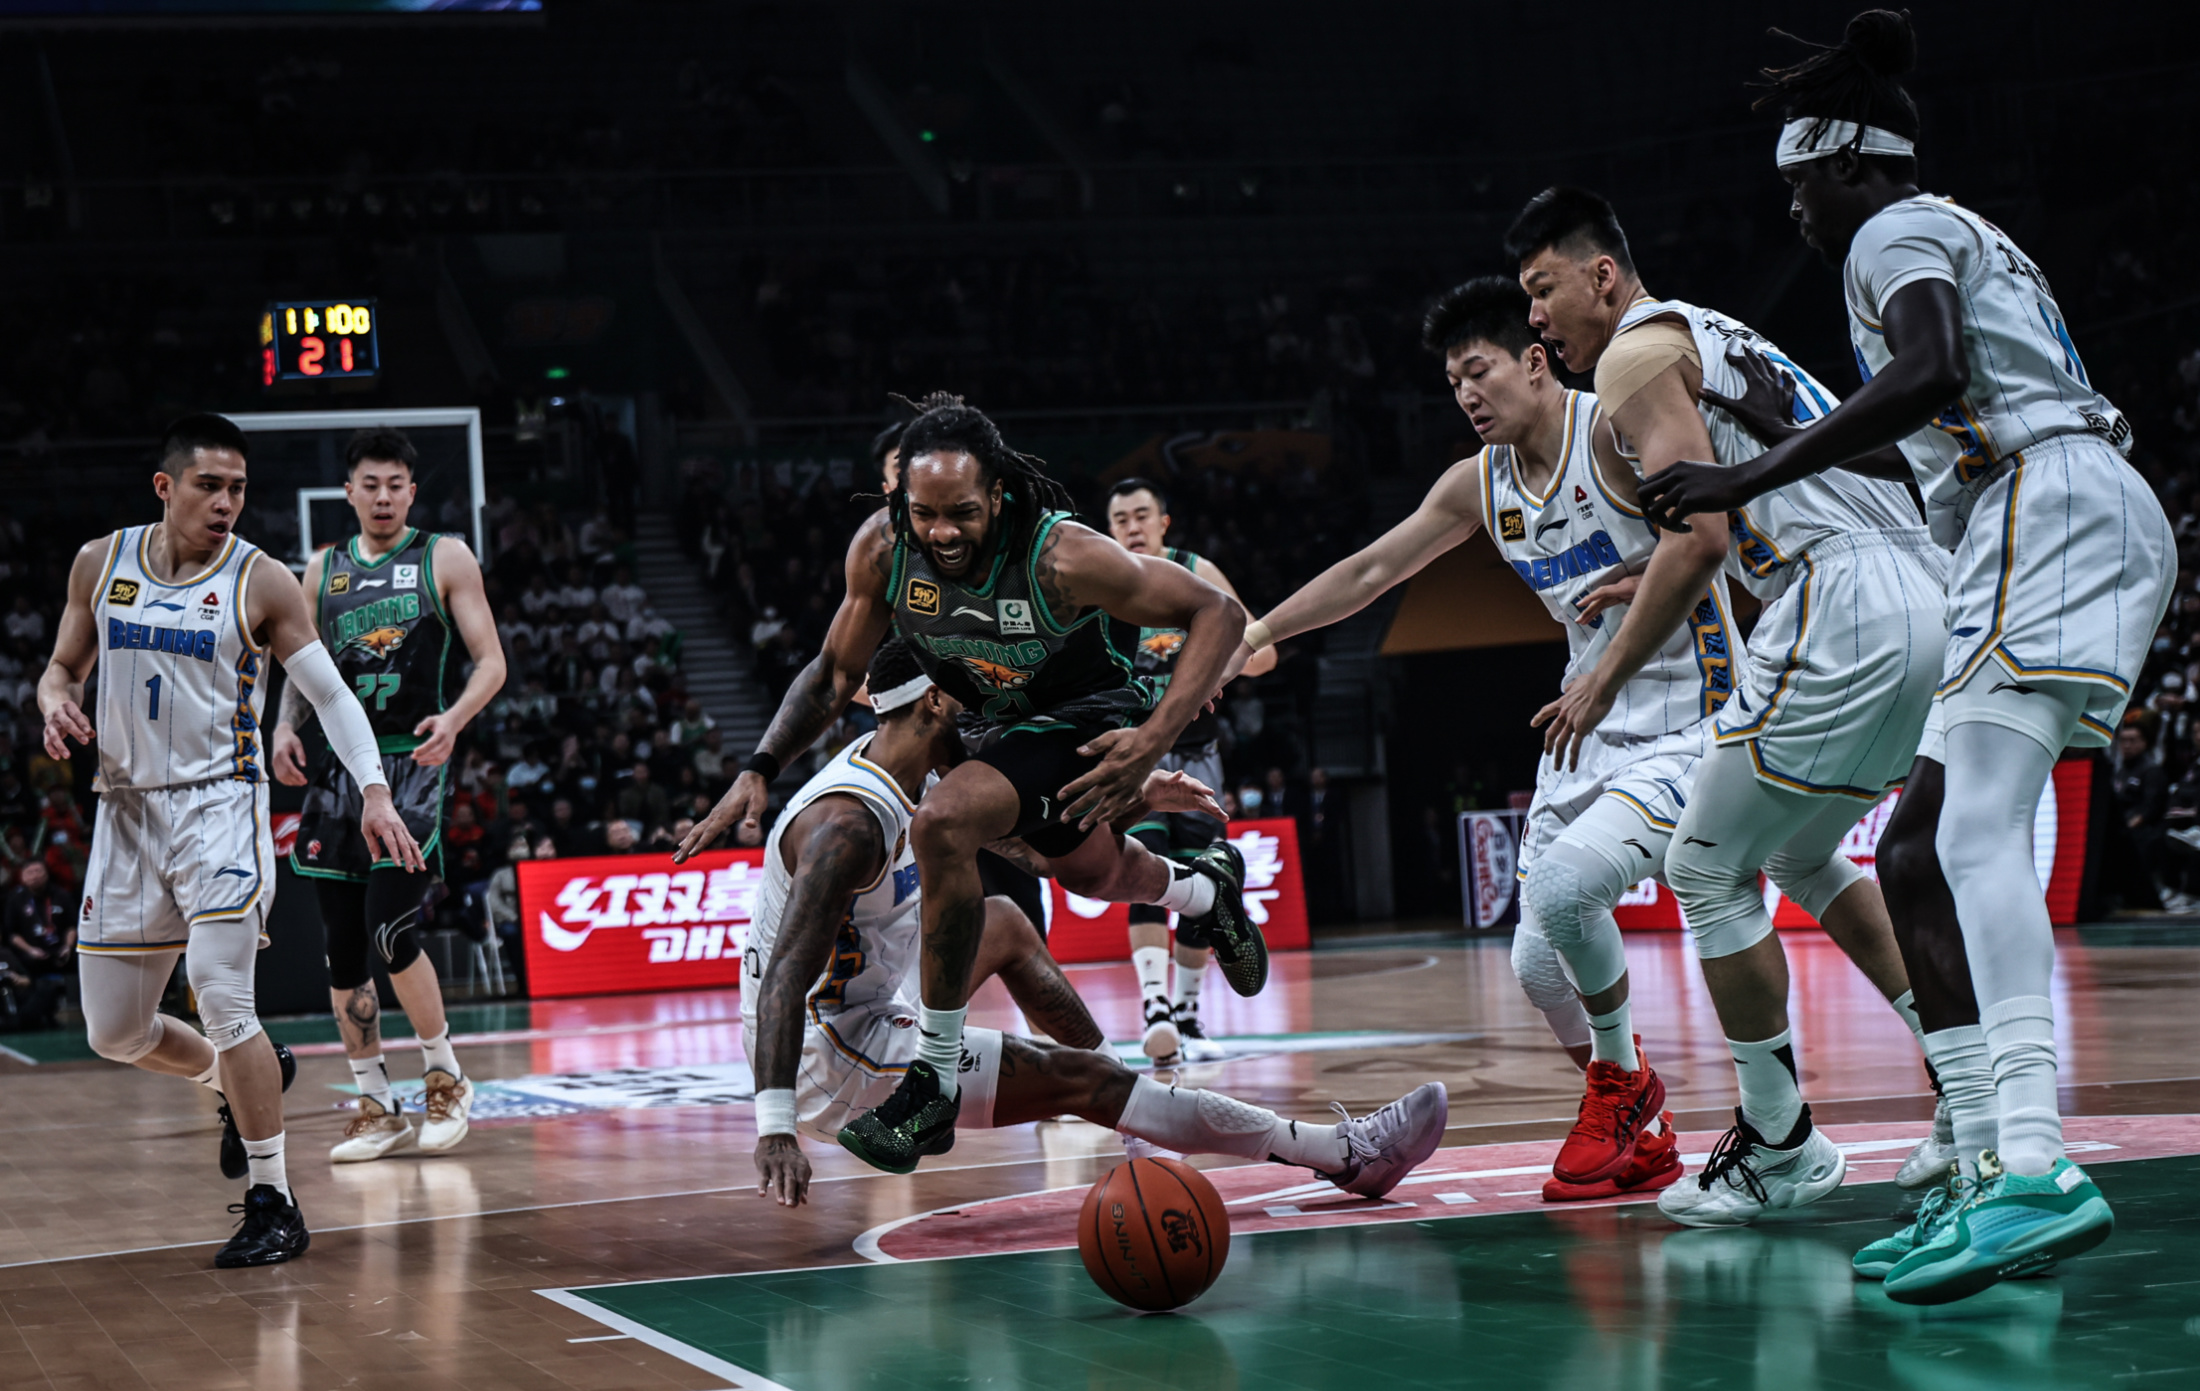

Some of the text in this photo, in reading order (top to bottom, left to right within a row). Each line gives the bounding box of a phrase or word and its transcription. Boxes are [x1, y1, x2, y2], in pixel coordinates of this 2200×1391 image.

[1511, 530, 1622, 592] BEIJING
[108, 616, 217, 663] BEIJING
[329, 593, 420, 655] LIAONING
[145, 674, 162, 721] 1
[356, 673, 401, 711] 77
[1111, 1203, 1151, 1290] LI-NING
